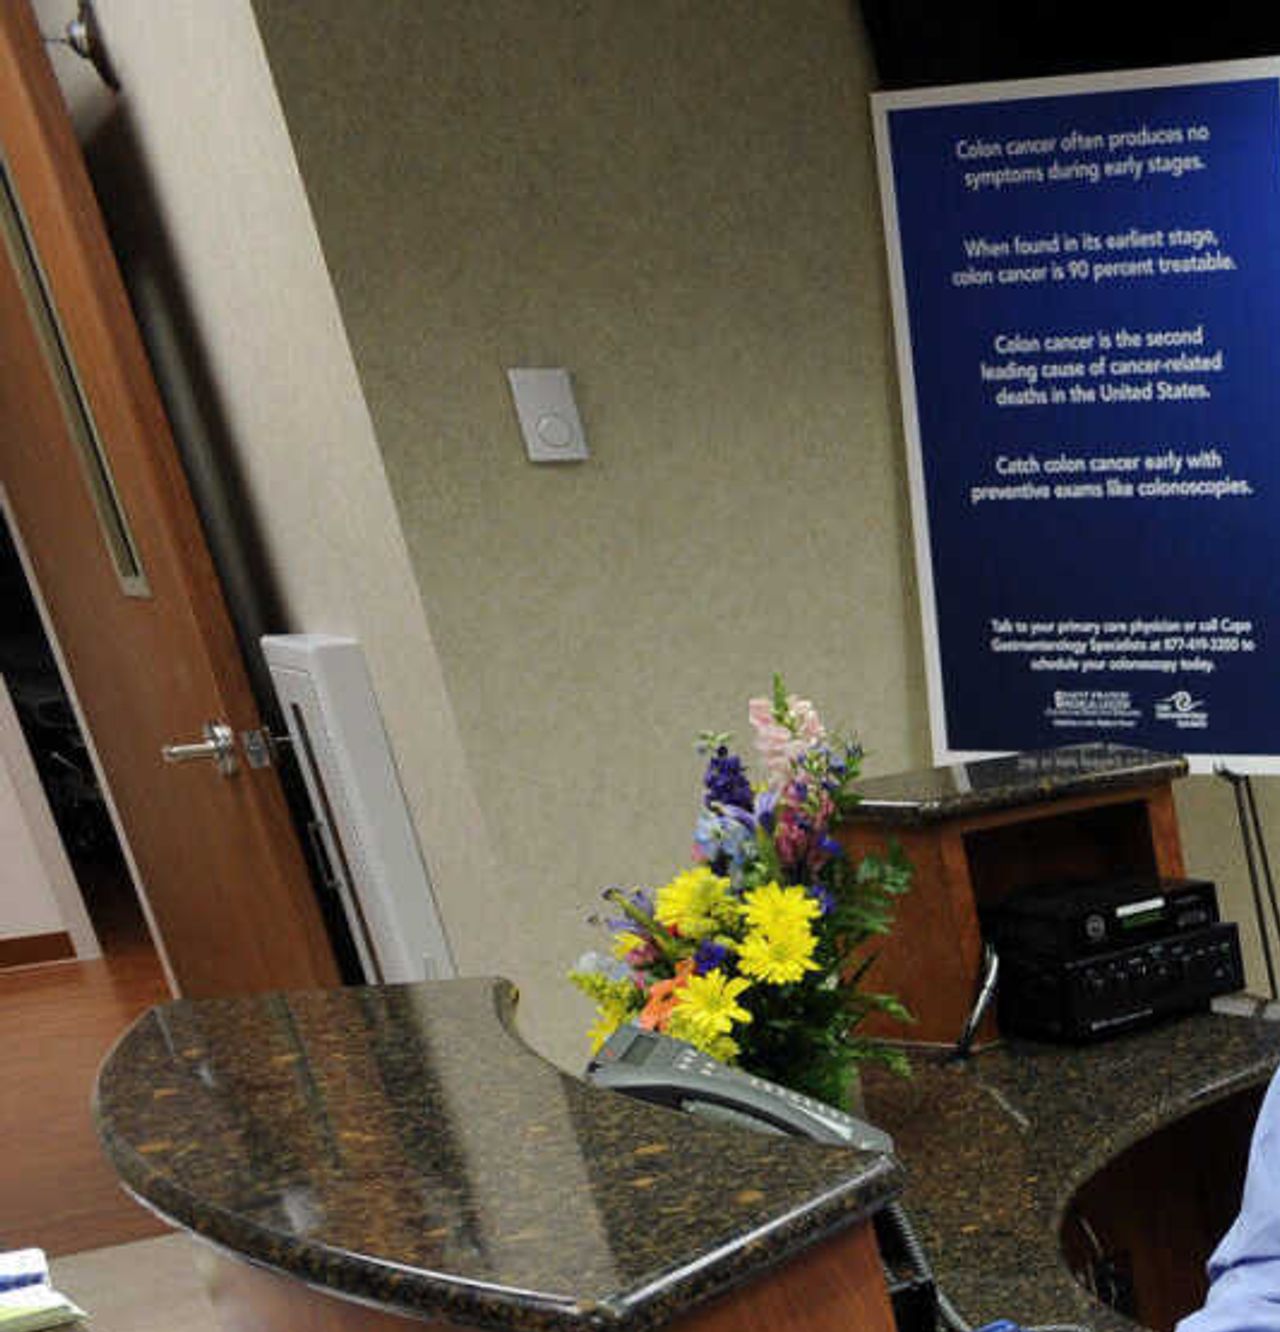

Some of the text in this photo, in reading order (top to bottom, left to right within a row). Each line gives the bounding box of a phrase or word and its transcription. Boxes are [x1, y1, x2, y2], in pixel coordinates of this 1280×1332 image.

[955, 125, 1211, 159] Colon cancer often produces no
[964, 153, 1206, 190] symptoms during early stages.
[963, 227, 1219, 258] When found in its earliest stage,
[952, 251, 1237, 287] colon cancer is 90 percent treatable.
[994, 326, 1204, 354] Colon cancer is the second
[980, 350, 1224, 384] leading cause of cancer-related
[995, 381, 1211, 406] deaths in the United States.
[995, 449, 1223, 474] Catch colon cancer early with
[971, 476, 1254, 504] preventive exams like colonoscopies.
[991, 619, 1012, 633] Talk
[1015, 621, 1028, 633] to
[1031, 622, 1055, 635] your
[1058, 620, 1100, 635] primary
[1103, 622, 1127, 632] care
[1130, 619, 1181, 634] physician
[1184, 621, 1197, 632] or
[1199, 618, 1218, 631] call
[1241, 640, 1255, 651] to
[1081, 660, 1106, 673] your
